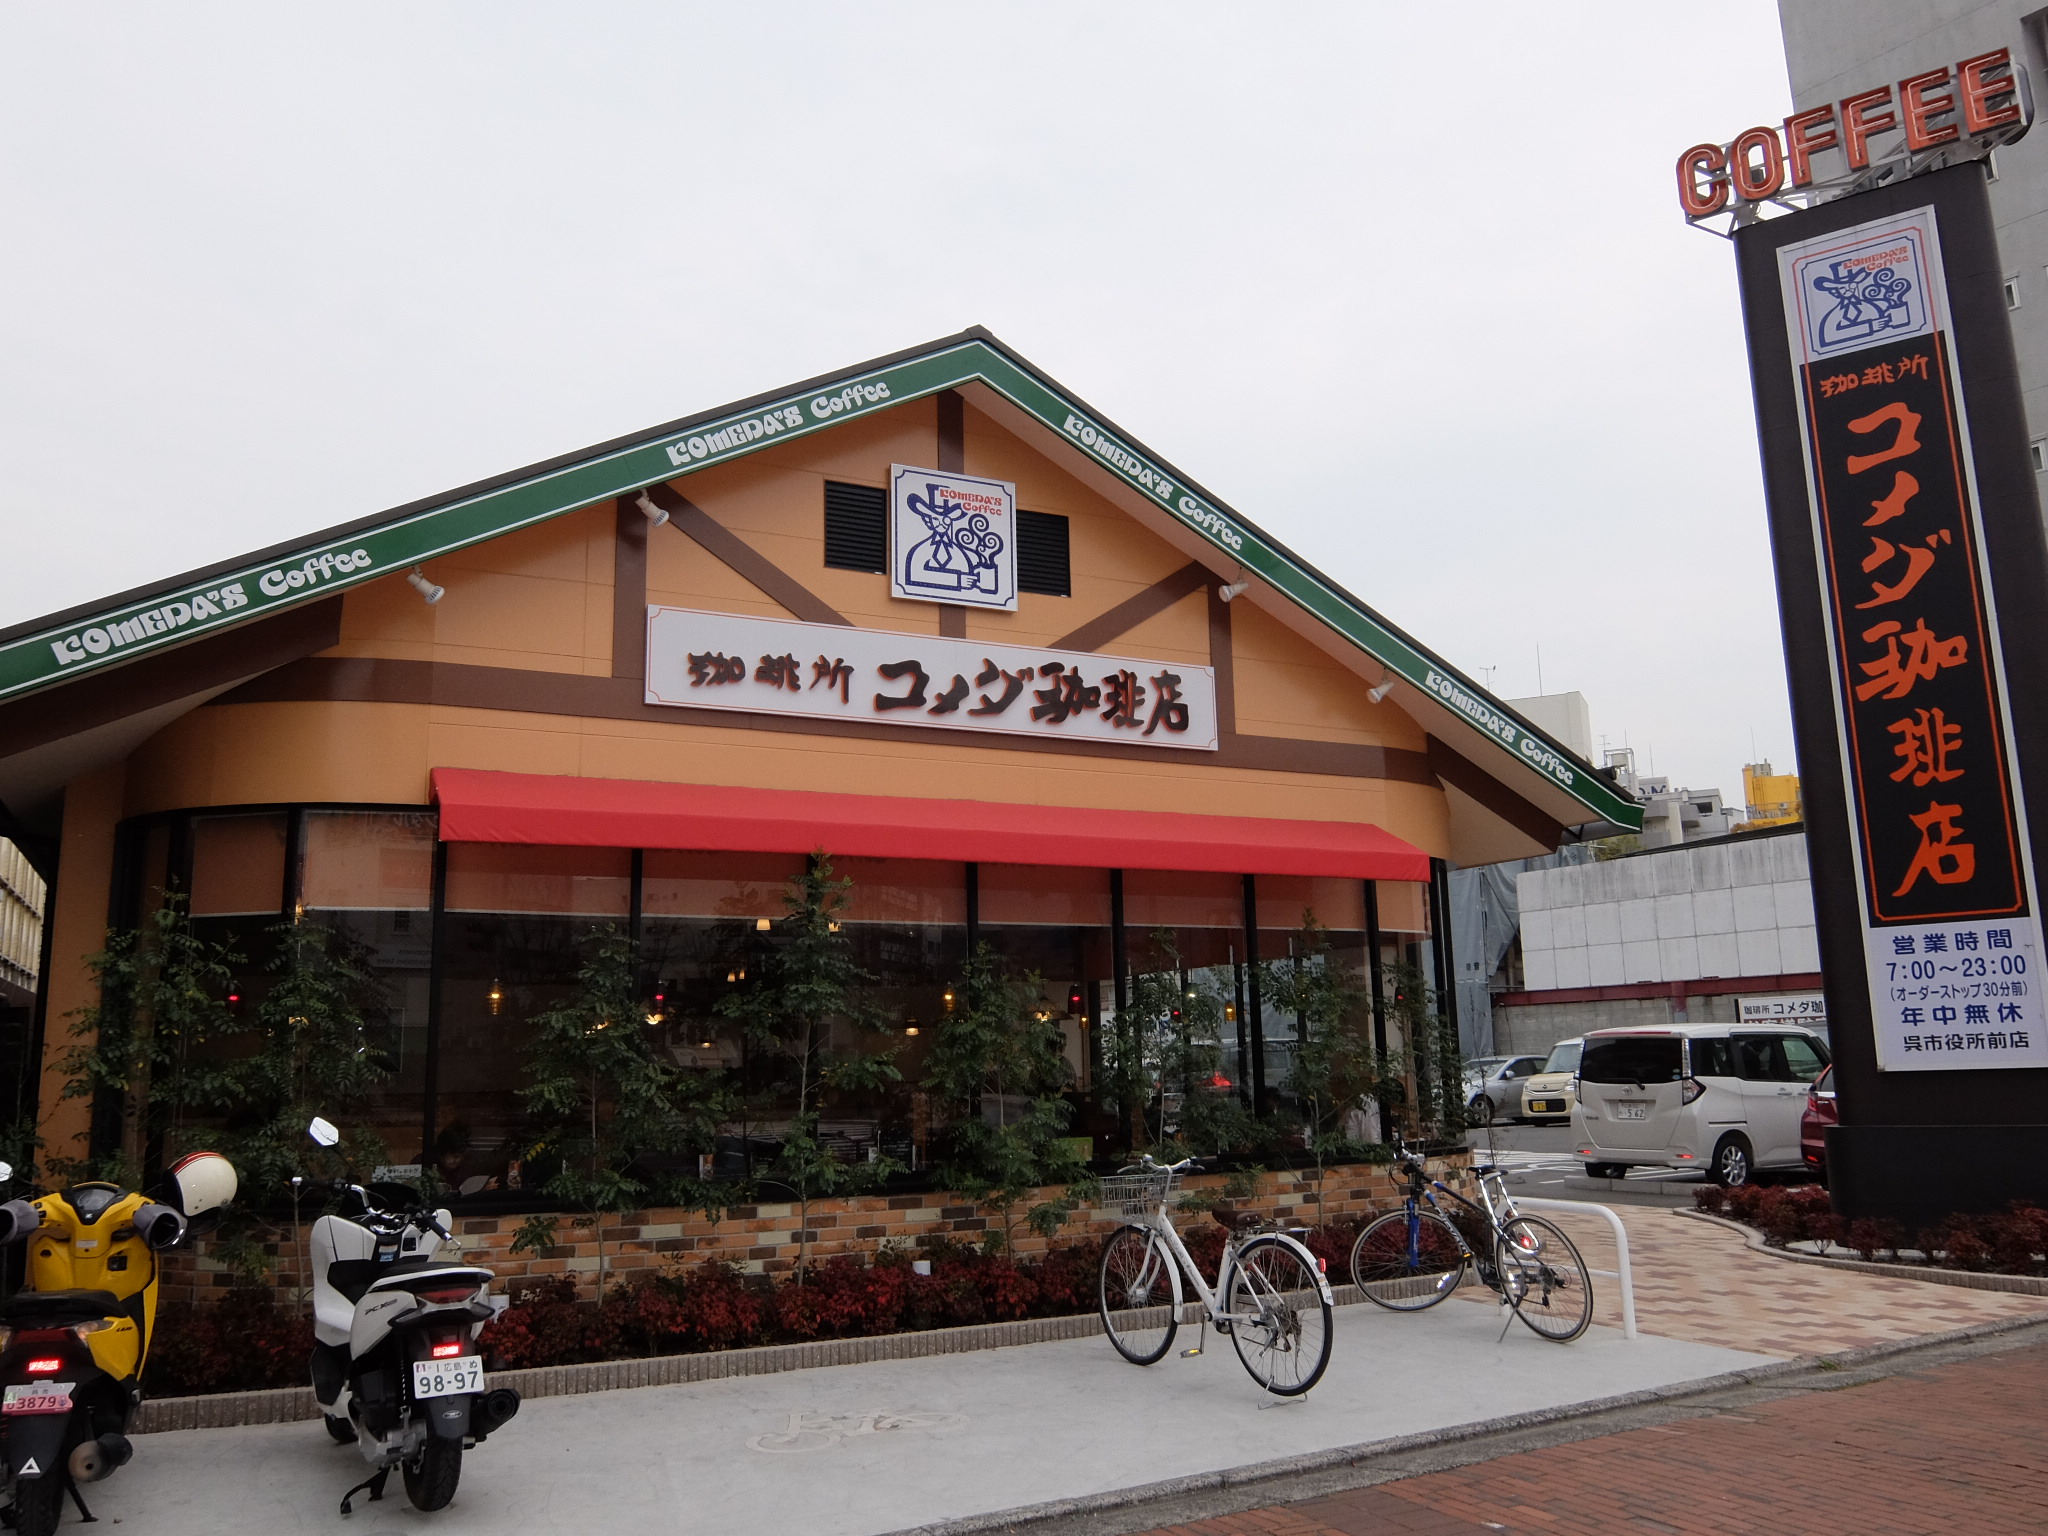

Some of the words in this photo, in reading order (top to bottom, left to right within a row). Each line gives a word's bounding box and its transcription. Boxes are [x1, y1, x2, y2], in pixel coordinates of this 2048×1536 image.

[1676, 47, 2023, 216] COFFEE
[1843, 246, 1908, 269] KOMEDA'S
[1867, 255, 1909, 271] Coffee
[666, 406, 804, 467] KOMEDA'S
[810, 382, 891, 419] Coffee
[1063, 414, 1174, 500] KOMEDA'S
[1178, 496, 1243, 551] Coffee
[940, 489, 1002, 507] KOMEDA'S
[962, 502, 1002, 516] Coffee
[51, 583, 249, 665] KOMEDA'S
[259, 549, 373, 597] Coffee
[1425, 670, 1517, 743] KOMEDA'S
[1520, 738, 1574, 785] Coffee
[1893, 929, 2013, 956] 営業時間
[1890, 980, 2028, 1002] (オーダーストップ30分前)
[1744, 1004, 1770, 1015] 珈琲所
[1901, 1002, 2024, 1027] 年中無休
[1903, 1031, 2030, 1053] 呉市役所前店
[419, 1371, 478, 1394] 98-97
[16, 1395, 57, 1410] 3879
